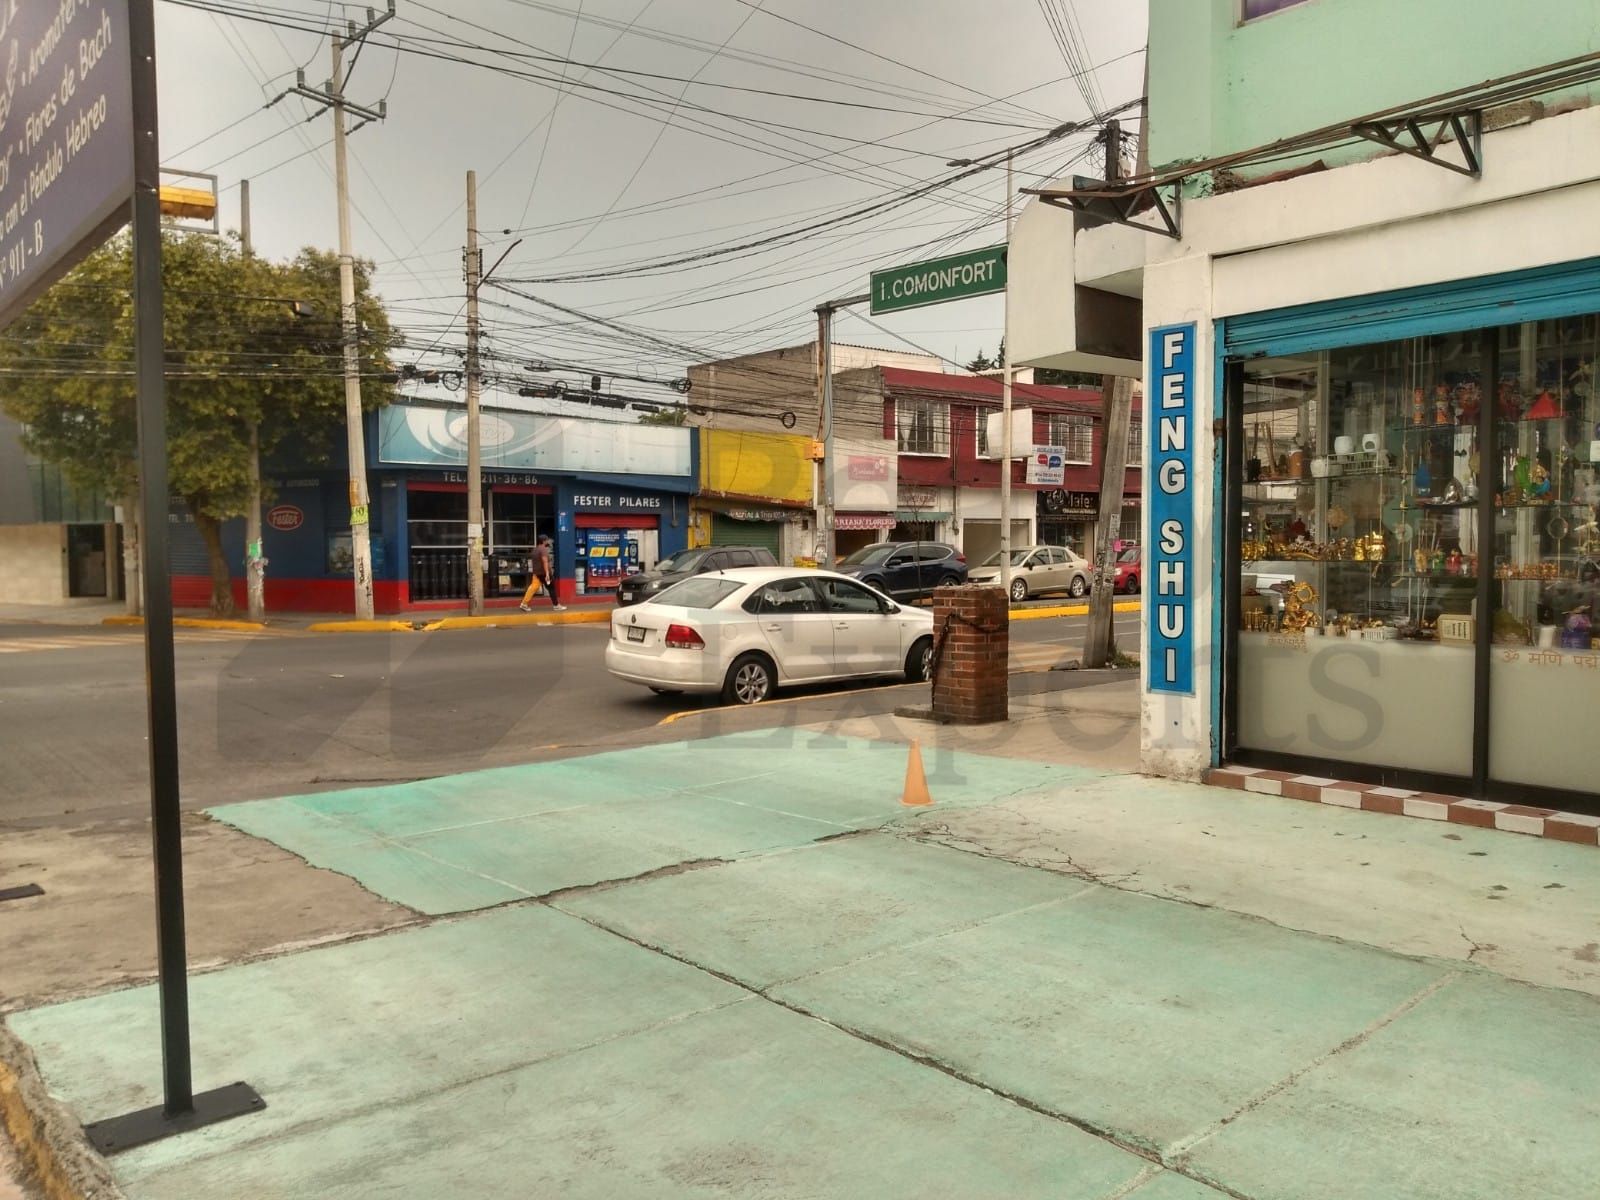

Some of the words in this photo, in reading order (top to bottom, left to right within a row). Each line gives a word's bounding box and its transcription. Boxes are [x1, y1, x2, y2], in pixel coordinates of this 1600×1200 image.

[25, 93, 57, 155] Flores
[60, 64, 76, 106] de
[79, 7, 112, 81] Bach
[5, 201, 19, 236] con
[20, 180, 29, 217] el
[29, 141, 63, 205] Péndulo
[65, 94, 107, 163] Hebreo
[34, 218, 44, 257] B
[442, 471, 467, 484] TEL.
[1157, 331, 1187, 496] FENG
[573, 495, 612, 507] FESTER
[619, 496, 661, 508] PILARES
[1157, 519, 1186, 684] SHUI
